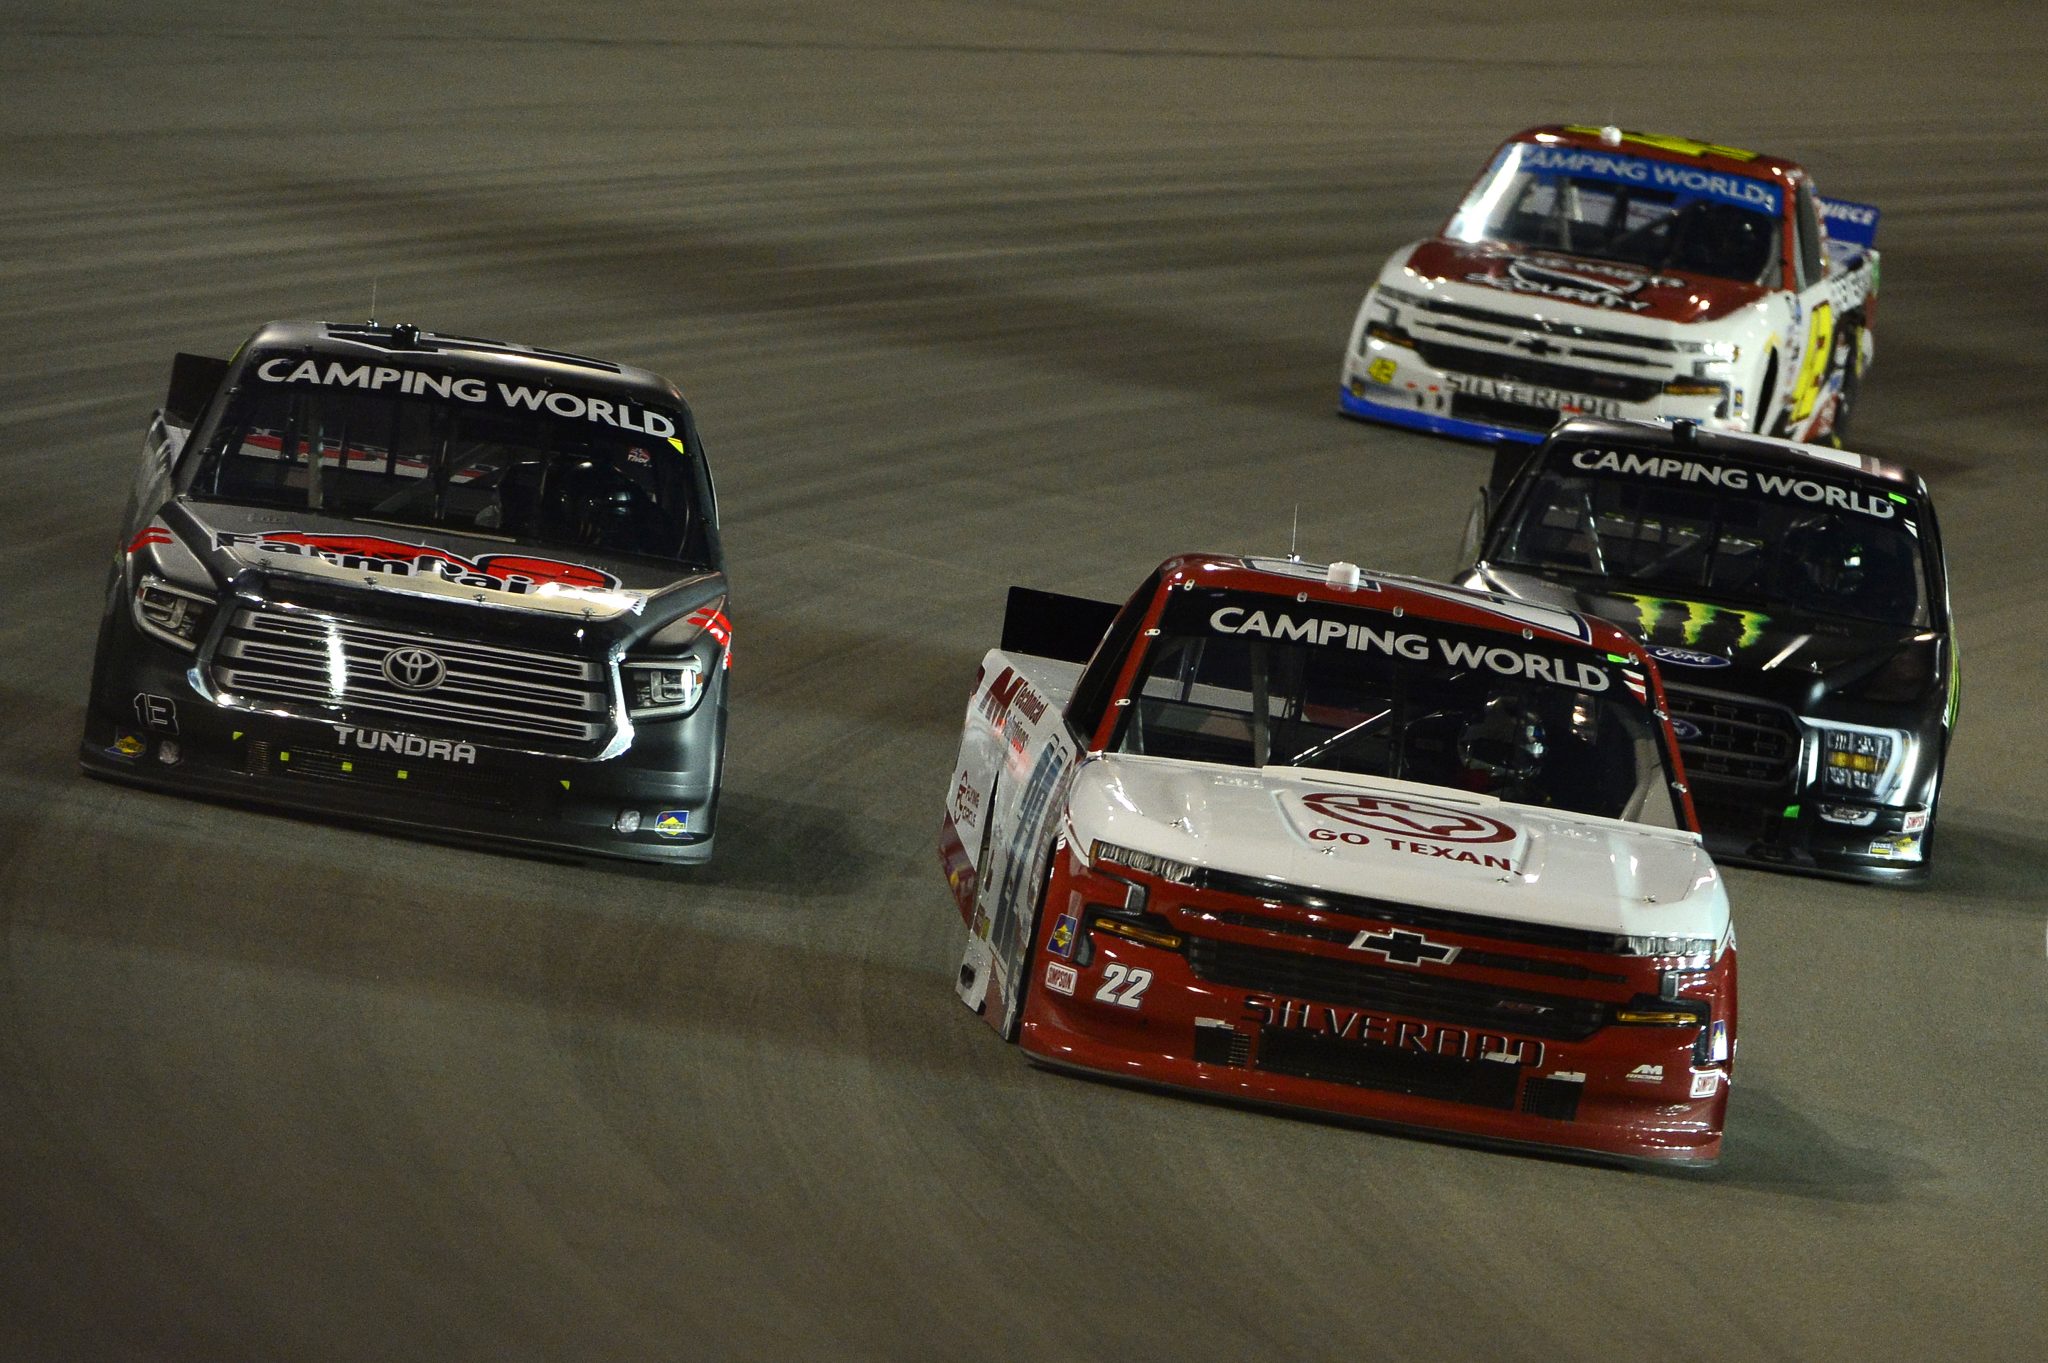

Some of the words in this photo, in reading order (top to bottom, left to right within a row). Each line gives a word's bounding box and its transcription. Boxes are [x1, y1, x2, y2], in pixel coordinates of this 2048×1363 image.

[1652, 167, 1767, 204] WORLD
[258, 358, 488, 402] CAMPING
[497, 383, 676, 438] WORLD
[1572, 450, 1748, 490] CAMPING
[1756, 473, 1896, 520] WORLD
[1210, 607, 1430, 660] CAMPING
[1438, 638, 1611, 692] WORLD
[133, 692, 180, 736] 13
[333, 725, 477, 765] TUNDRA
[1308, 828, 1371, 846] GO
[1095, 963, 1153, 1009] 22
[1242, 994, 1545, 1069] SILVERADO
